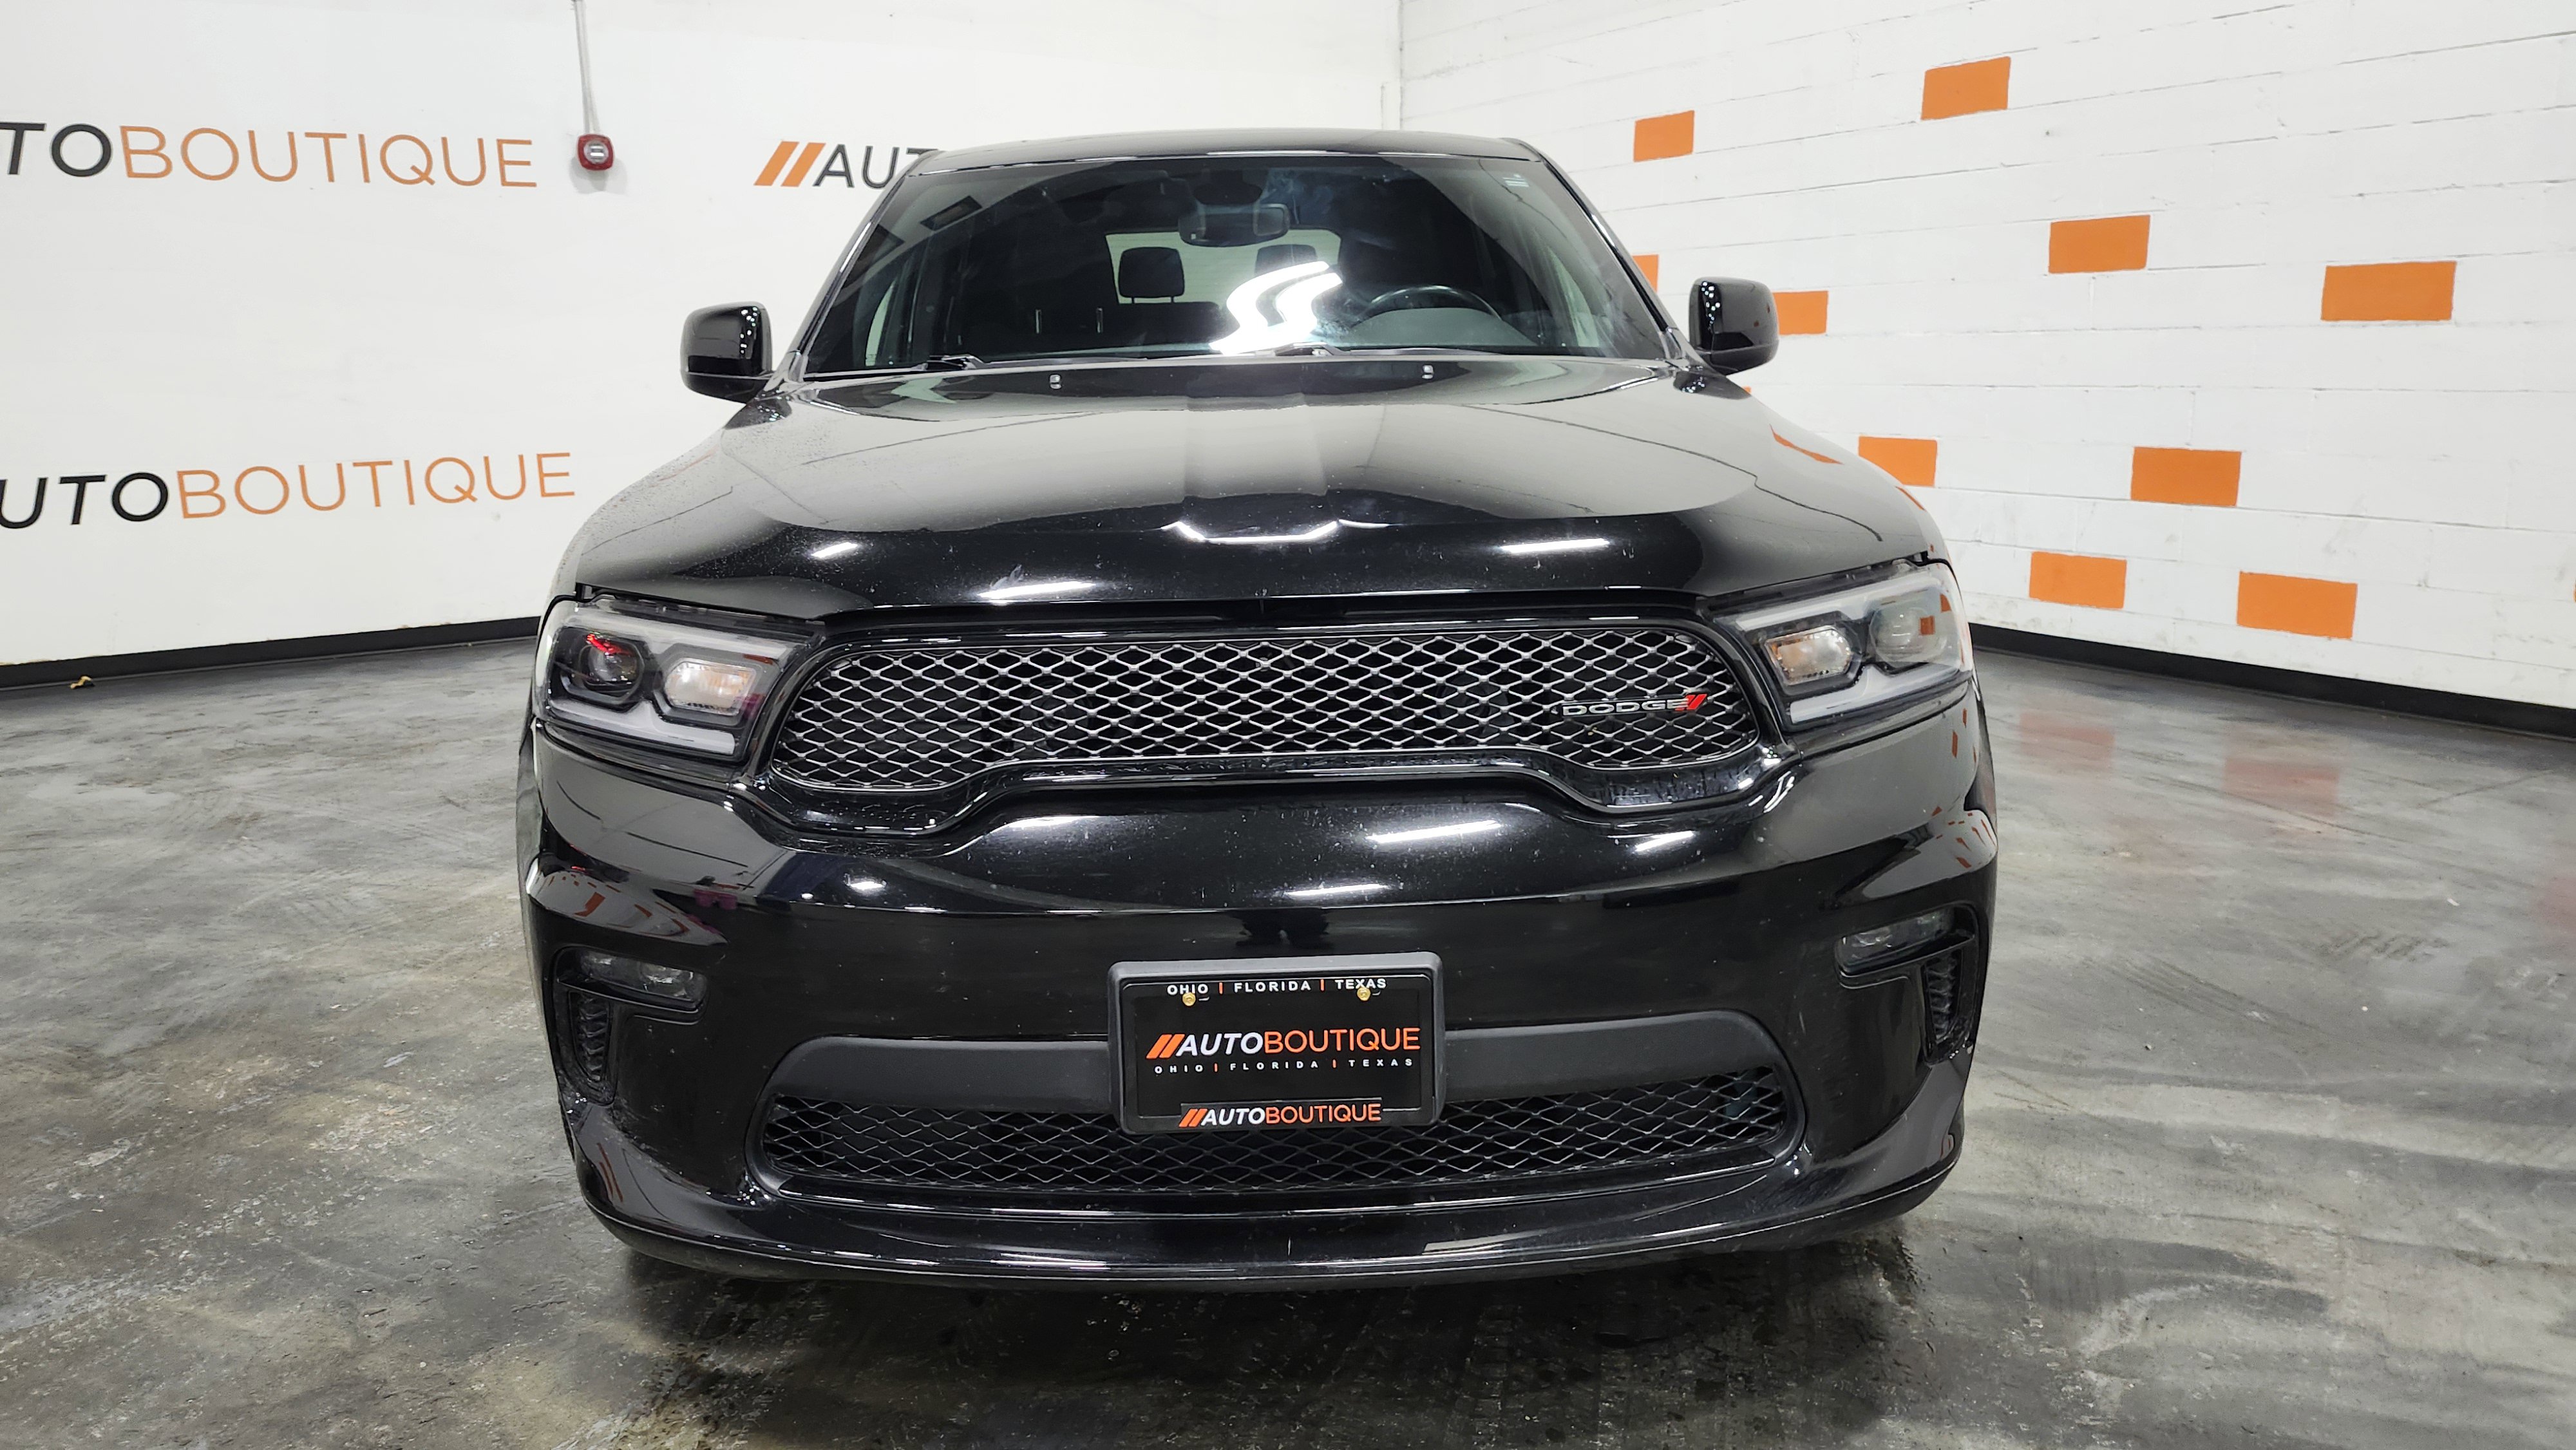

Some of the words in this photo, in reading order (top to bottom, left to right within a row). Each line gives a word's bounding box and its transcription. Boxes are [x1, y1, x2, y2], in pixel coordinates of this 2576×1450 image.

[0, 452, 576, 529] UTOBOUTIQUE
[1562, 698, 1689, 716] DODGE
[1166, 983, 1209, 996] OHIO
[1234, 979, 1311, 993] FLORIDA
[1334, 977, 1387, 990] TEXAS
[1175, 1027, 1421, 1057] AUTOBOUTIQUE
[1154, 1064, 1204, 1075] OHIO
[1229, 1060, 1318, 1071] FLORIDA
[1348, 1058, 1413, 1068] TEXAS
[1200, 1103, 1382, 1126] AUTOBOUTIQUE
